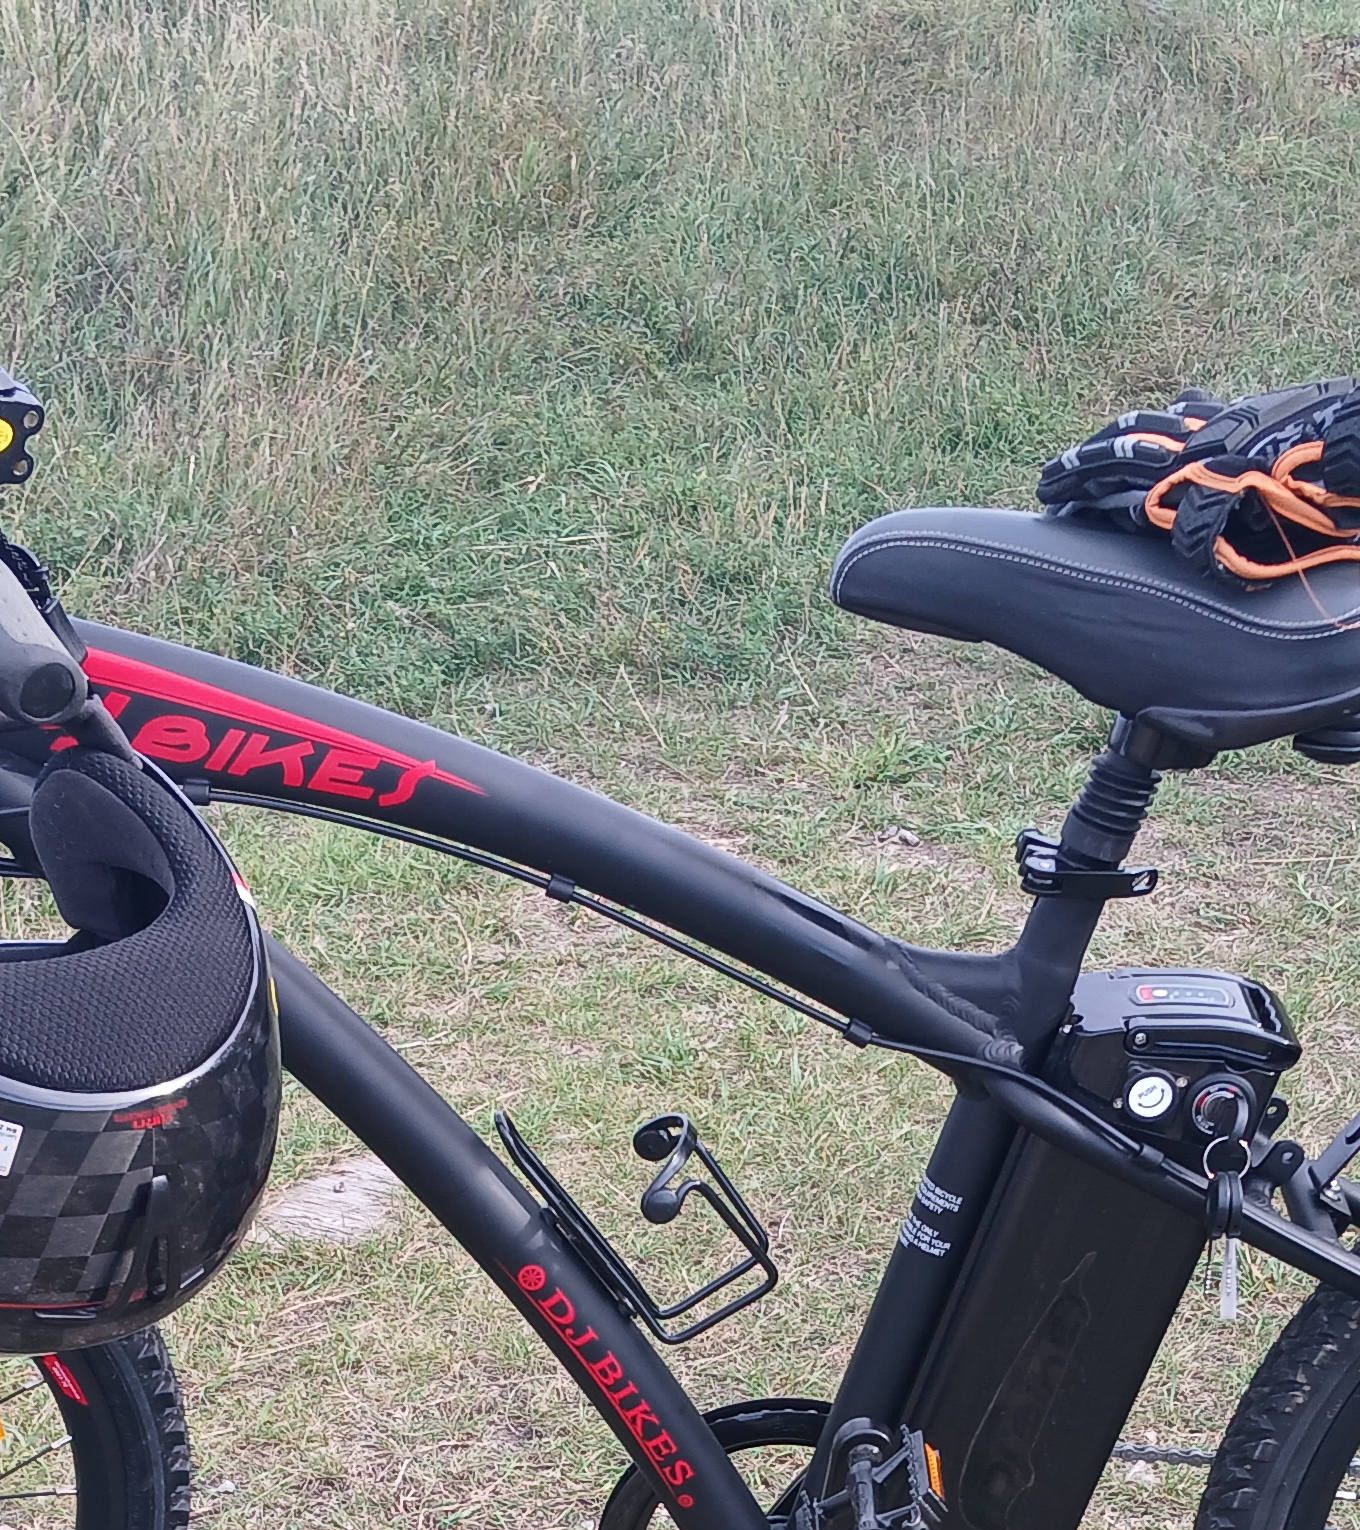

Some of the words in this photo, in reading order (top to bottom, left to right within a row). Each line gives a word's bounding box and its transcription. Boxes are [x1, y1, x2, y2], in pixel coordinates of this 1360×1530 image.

[133, 713, 438, 807] BIKES
[1137, 1085, 1158, 1099] PUSH
[541, 1287, 600, 1348] DJ
[589, 1351, 696, 1487] BIKES
